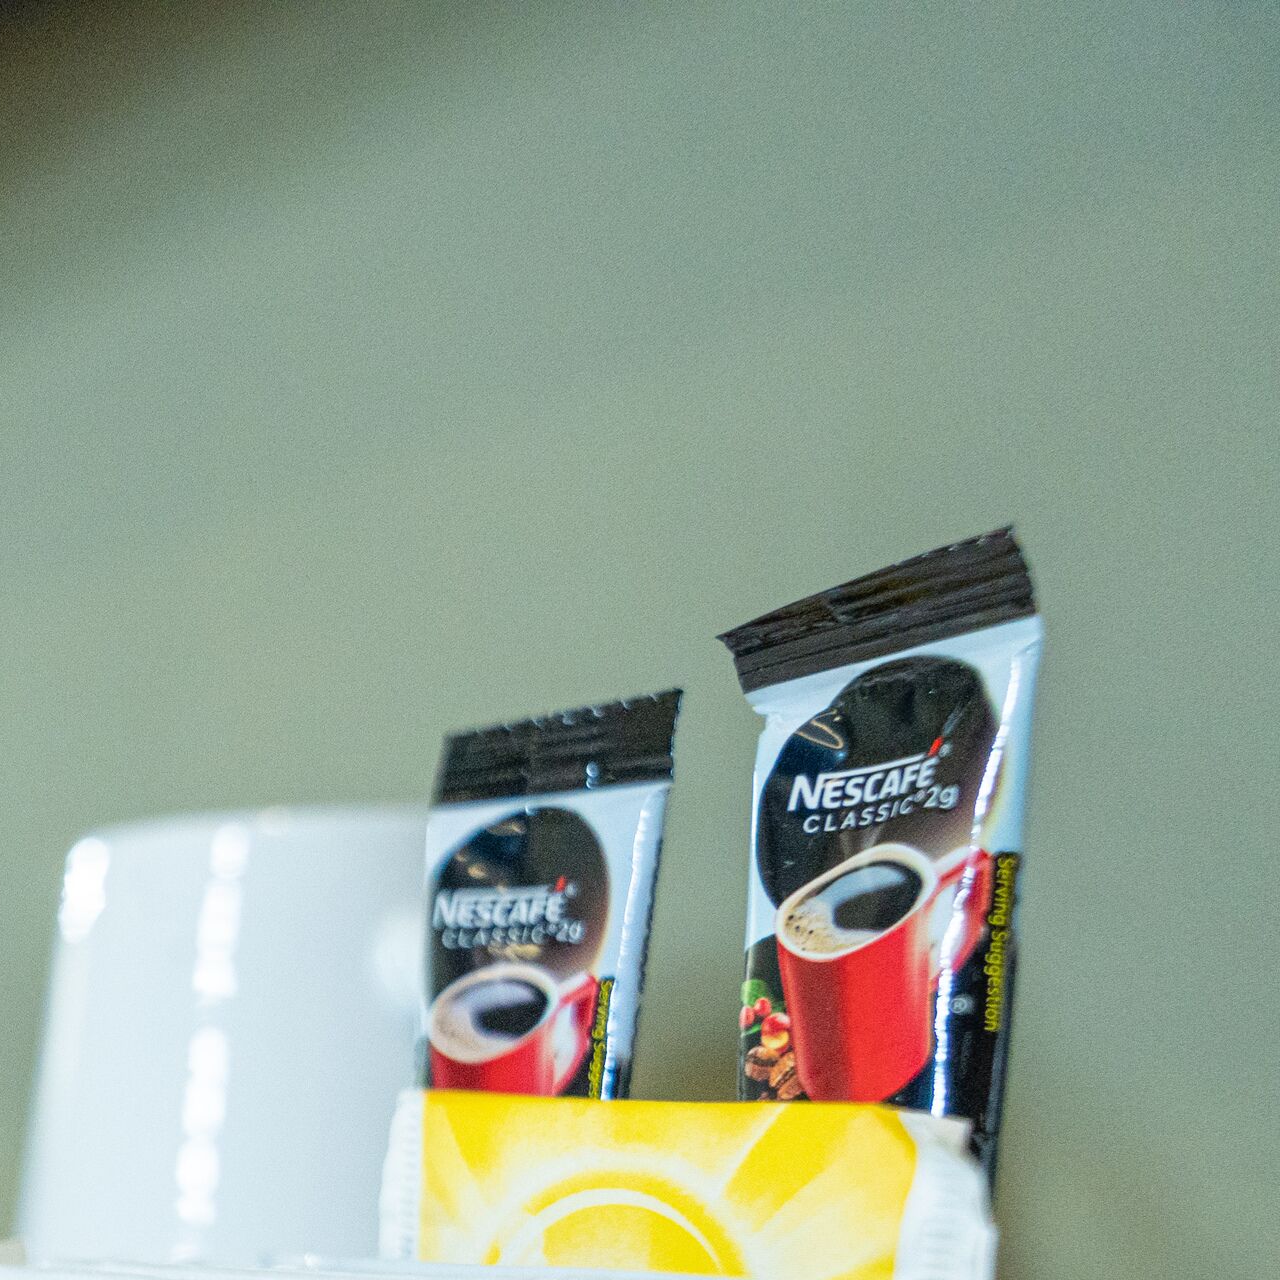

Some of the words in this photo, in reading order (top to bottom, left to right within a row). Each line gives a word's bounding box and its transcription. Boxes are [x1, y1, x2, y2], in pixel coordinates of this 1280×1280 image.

[803, 795, 913, 834] CLASSIC
[923, 784, 960, 810] 2g
[987, 857, 1016, 926] Serving
[984, 931, 1008, 1033] Suggestion
